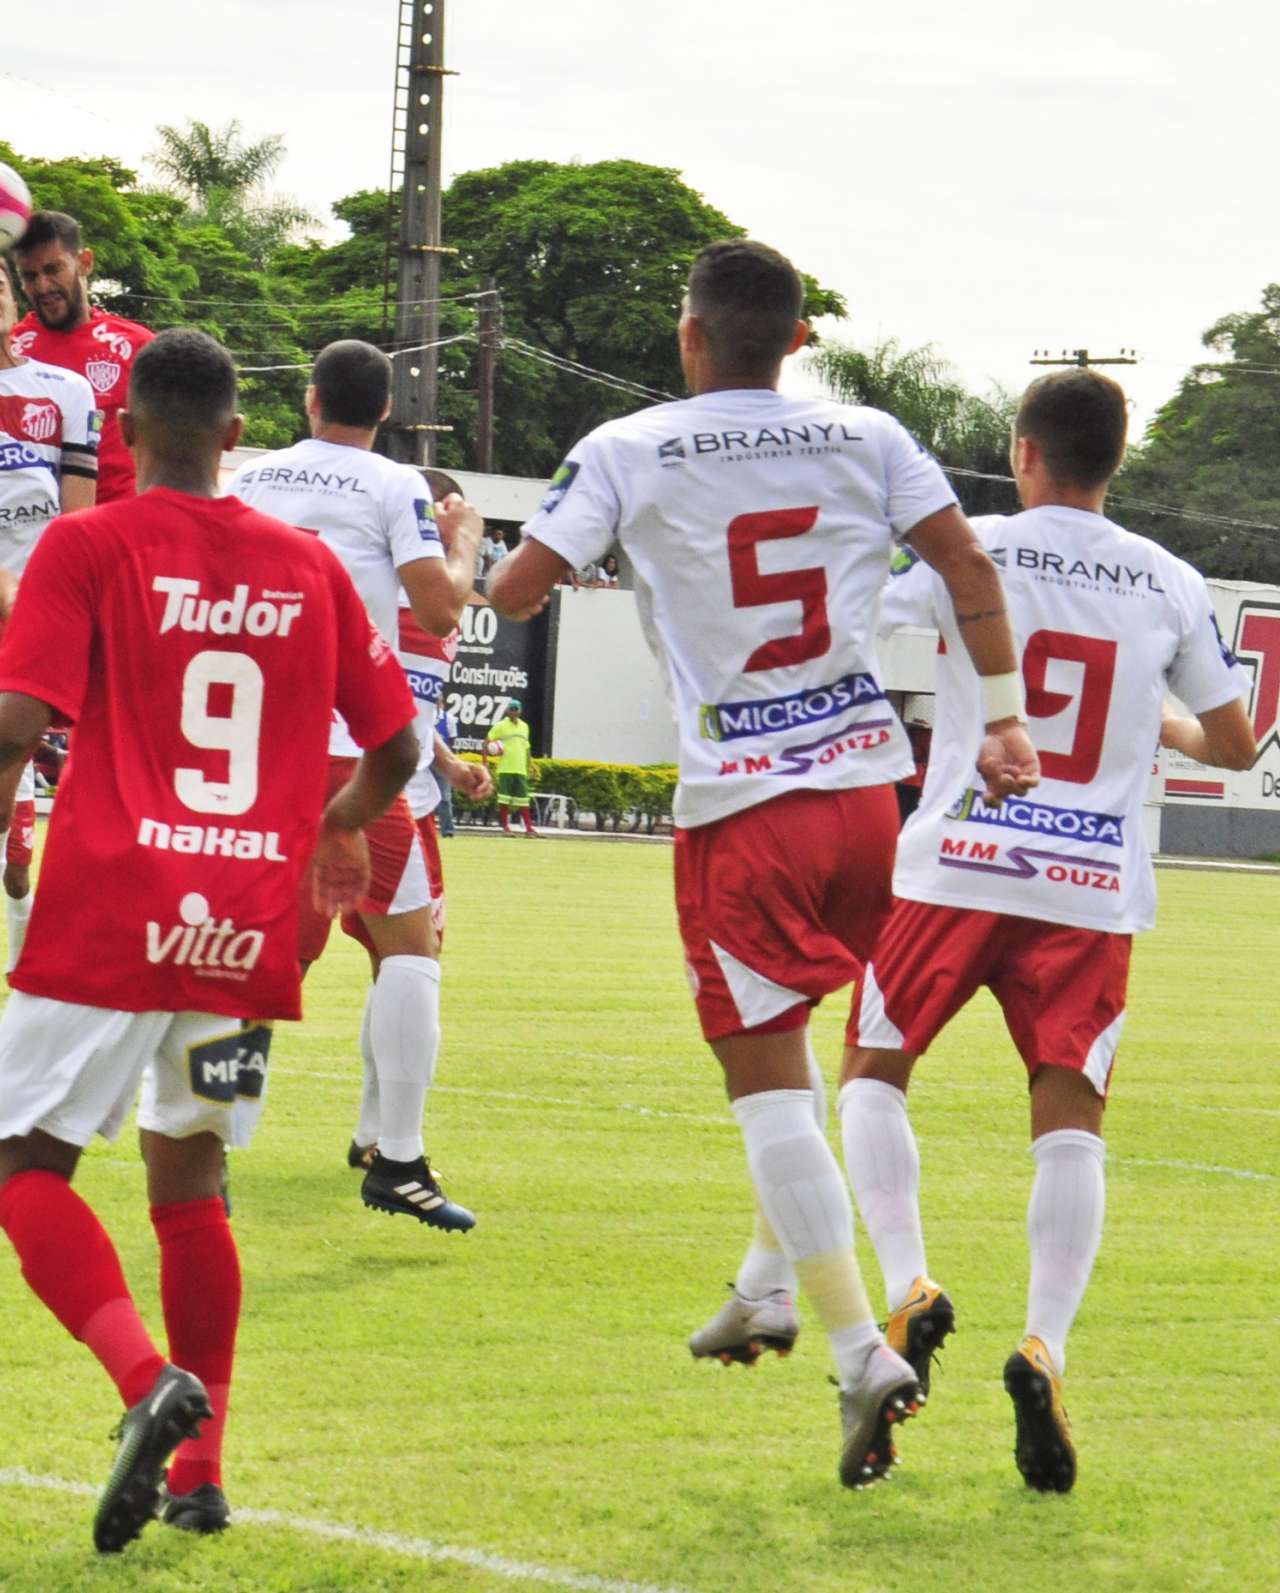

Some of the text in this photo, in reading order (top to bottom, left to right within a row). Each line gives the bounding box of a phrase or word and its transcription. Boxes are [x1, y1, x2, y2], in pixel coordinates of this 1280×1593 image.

[693, 422, 864, 454] BRANYL
[258, 467, 366, 493] BRANYL
[727, 505, 832, 674] 5
[1016, 547, 1165, 594] BRANYL
[152, 576, 303, 637] Tudor
[452, 661, 528, 693] Construções
[720, 675, 878, 734] MICROSA
[1022, 629, 1118, 784] 9
[173, 650, 265, 816] 9
[971, 796, 1122, 842] MICROSA
[146, 892, 265, 971] vitta
